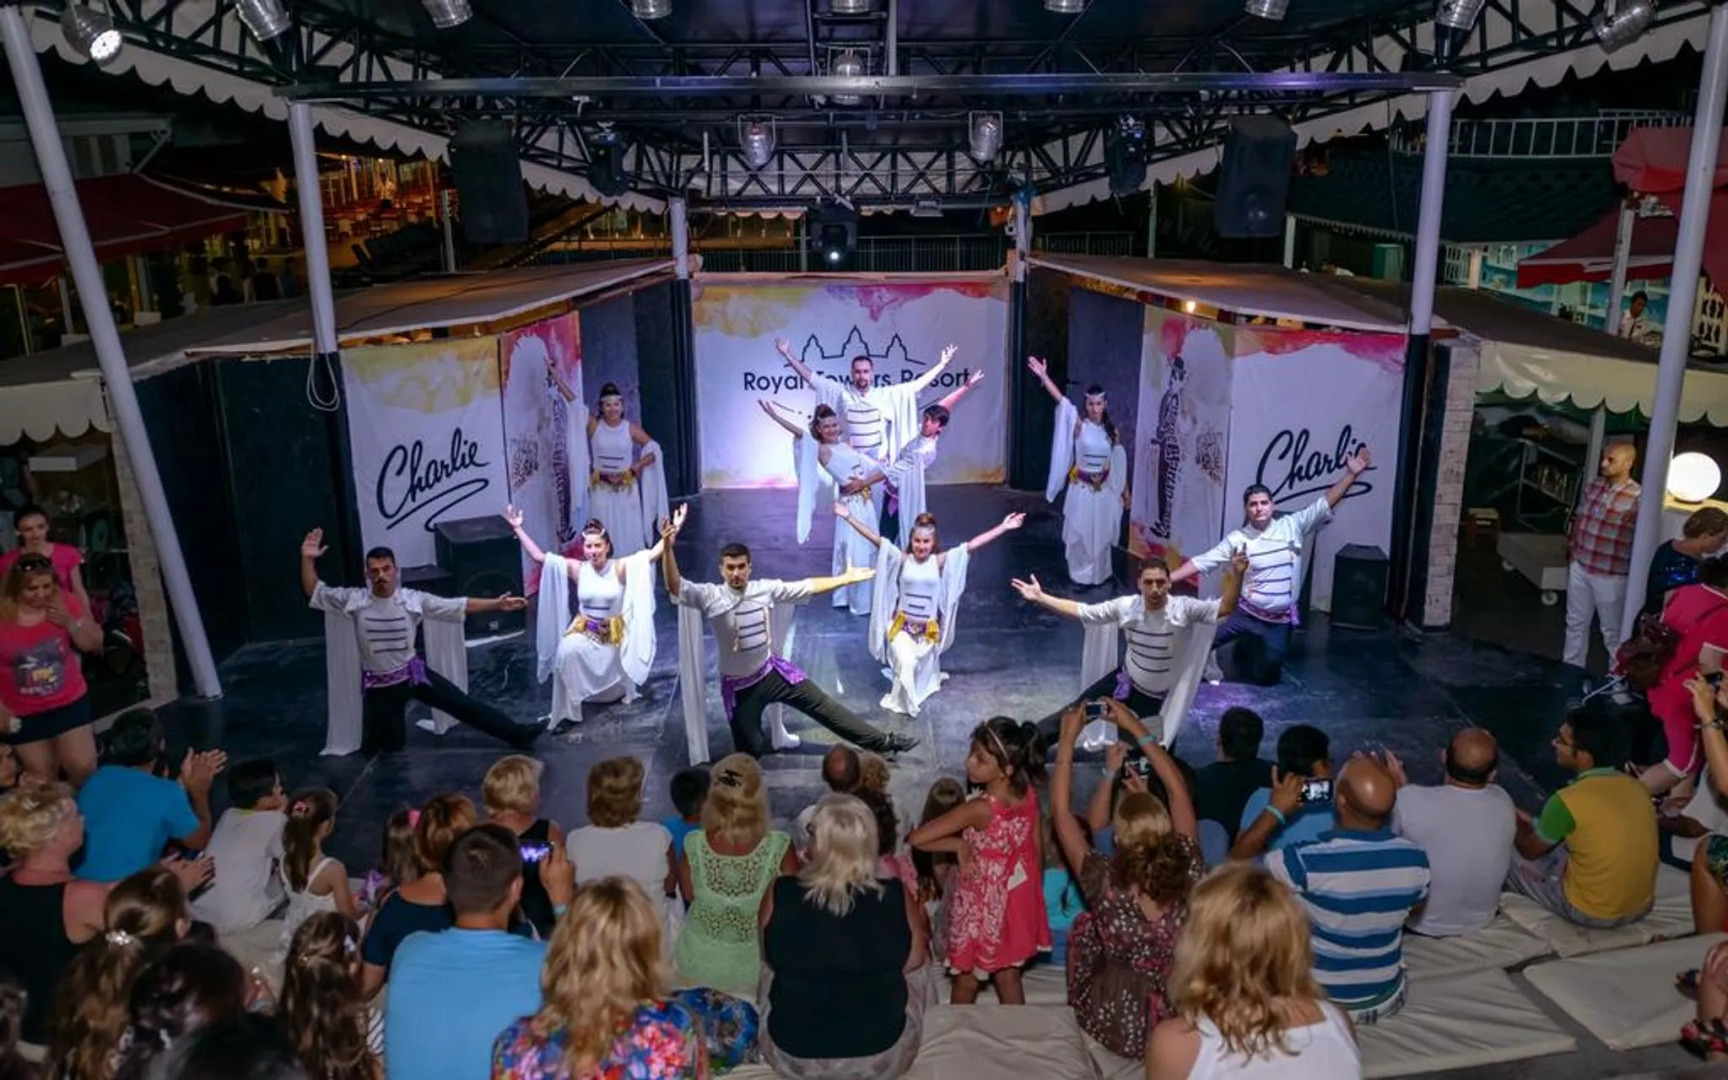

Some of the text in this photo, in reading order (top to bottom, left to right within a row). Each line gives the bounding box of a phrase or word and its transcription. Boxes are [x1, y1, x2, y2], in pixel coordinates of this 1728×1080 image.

[743, 368, 970, 395] Royal wrs Rsort
[376, 427, 490, 519] Charlie
